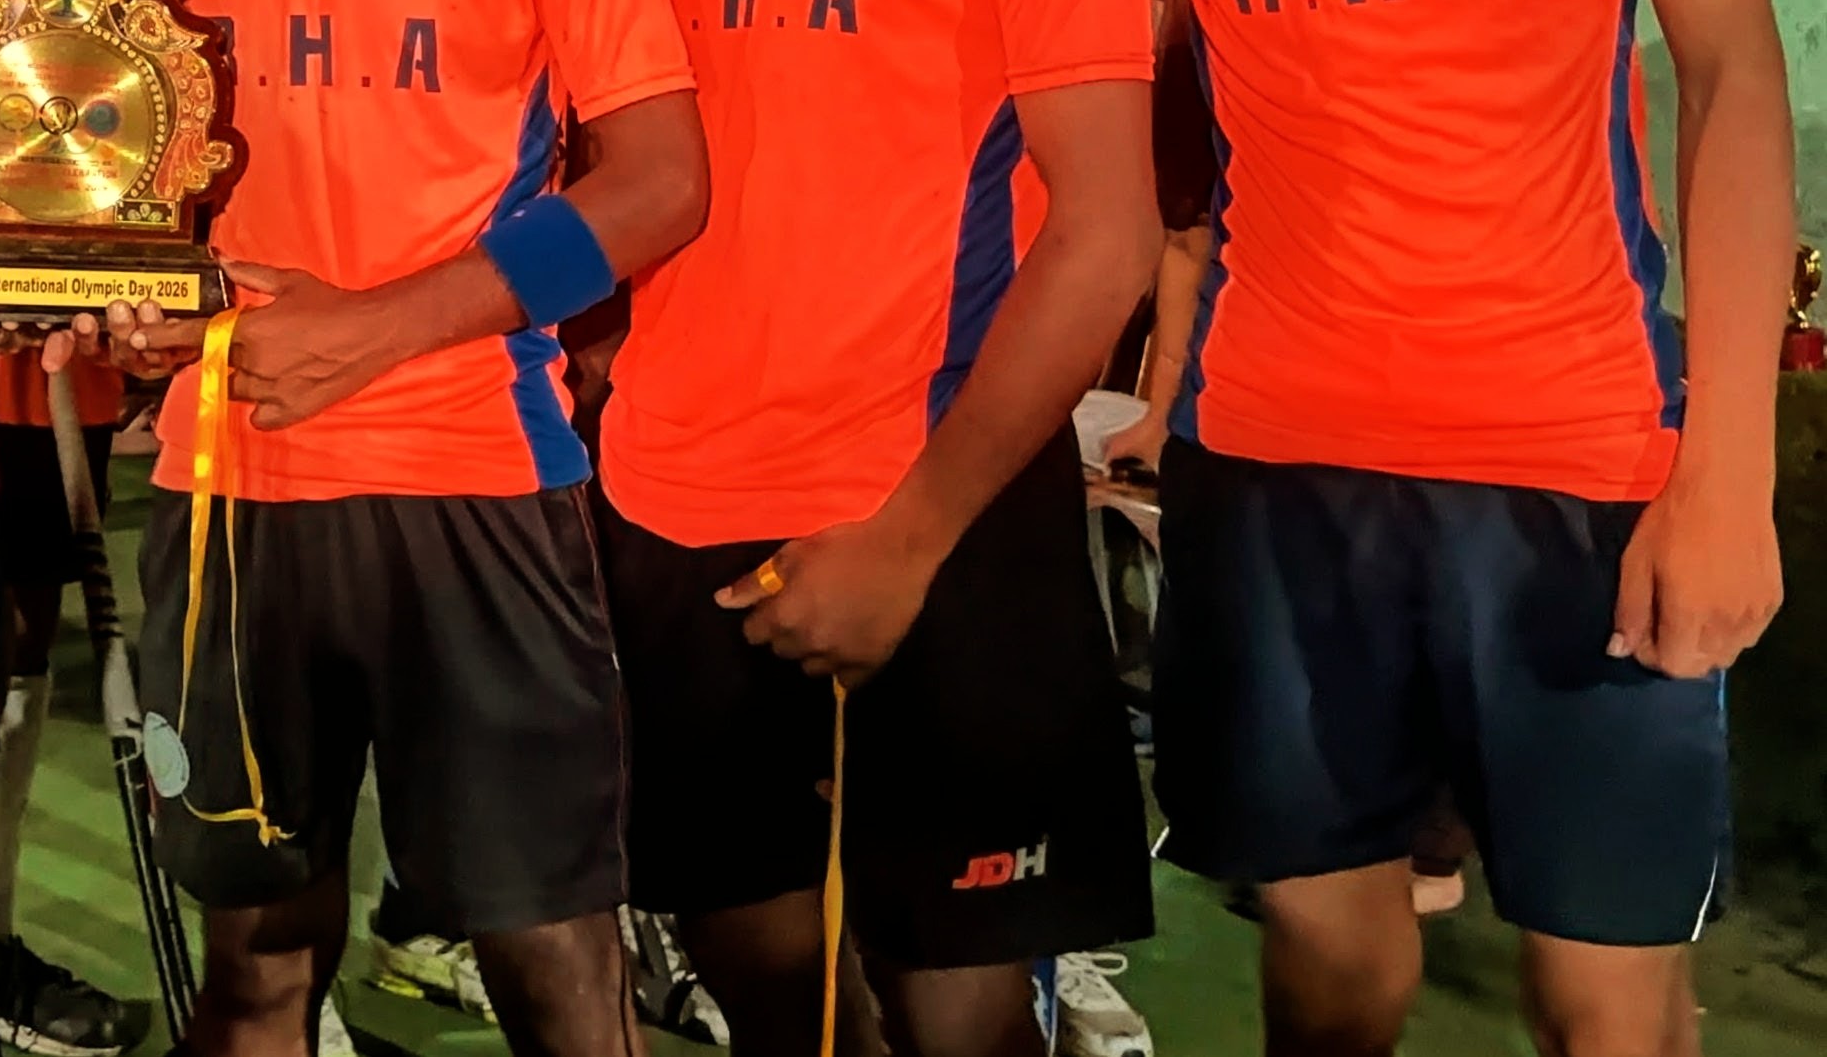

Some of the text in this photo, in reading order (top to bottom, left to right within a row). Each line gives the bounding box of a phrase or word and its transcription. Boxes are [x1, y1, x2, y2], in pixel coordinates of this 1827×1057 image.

[72, 277, 124, 299] Olympic
[128, 280, 154, 300] Day
[156, 281, 189, 298] 2026
[952, 841, 1048, 889] JDH
